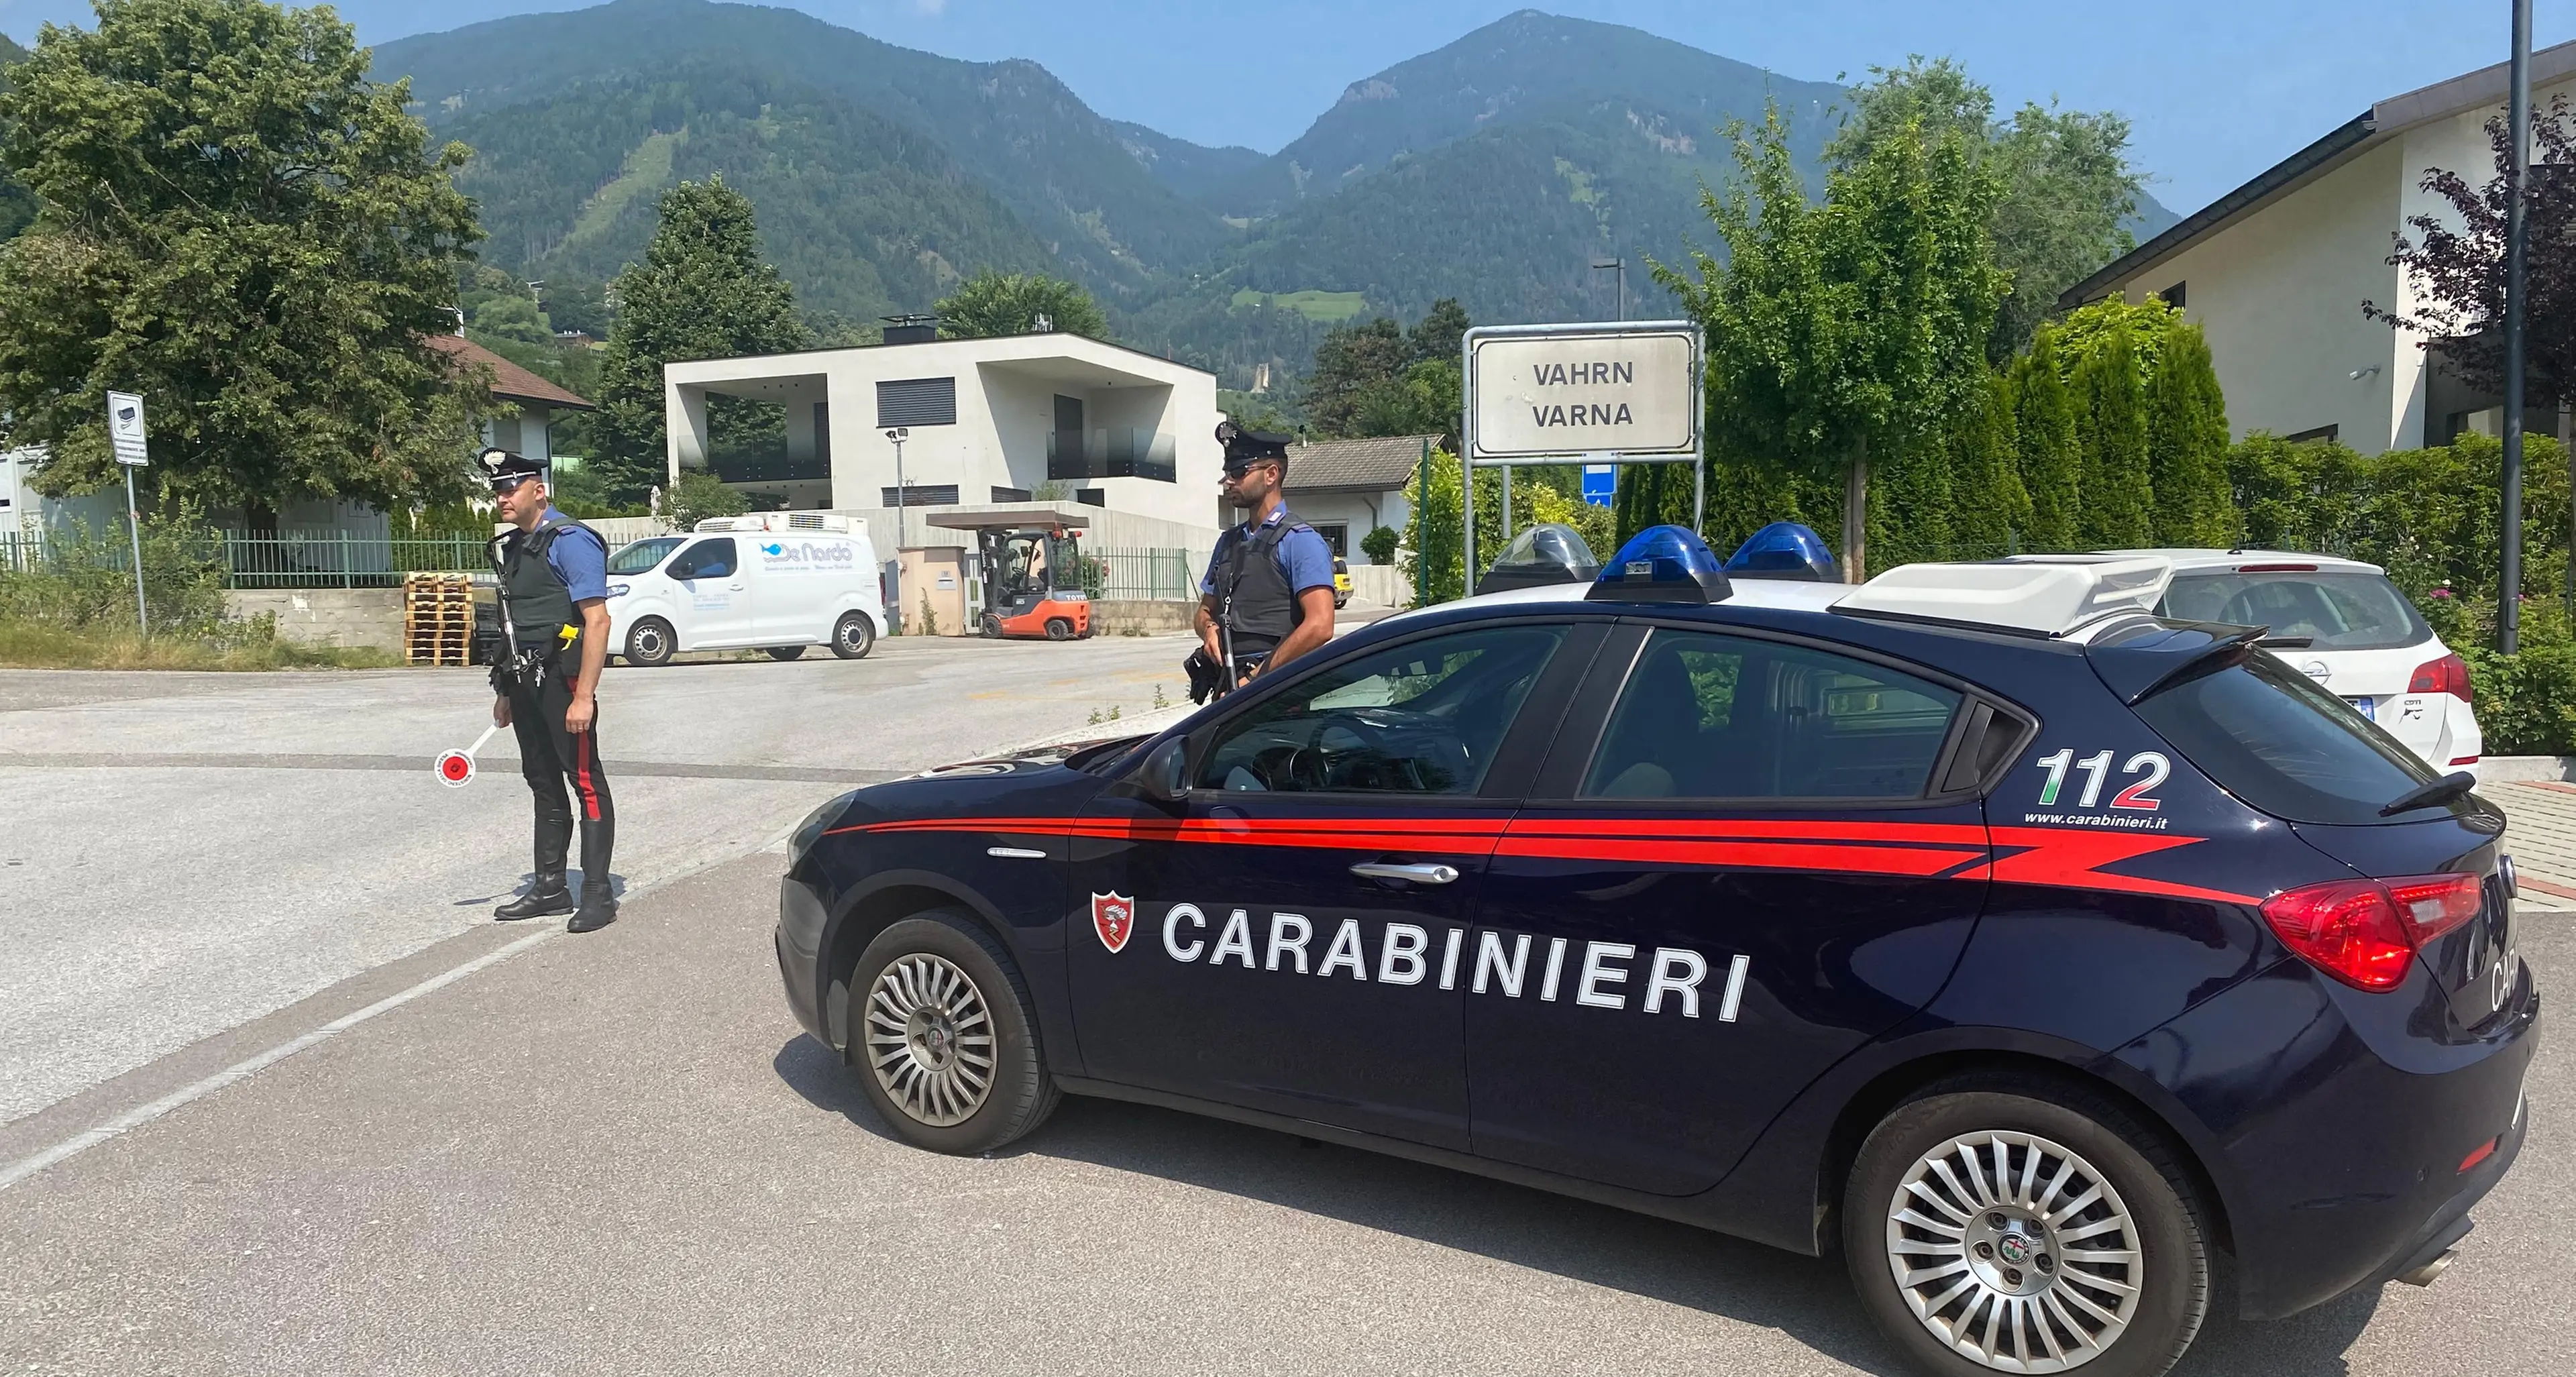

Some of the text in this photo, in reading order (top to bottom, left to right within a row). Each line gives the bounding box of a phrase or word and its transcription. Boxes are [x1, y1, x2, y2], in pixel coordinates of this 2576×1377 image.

[1534, 362, 1633, 386] VAHRN
[1532, 403, 1633, 427] VARNA
[765, 543, 801, 562] De
[2037, 749, 2171, 811] 112
[2025, 812, 2168, 830] www.carabinieri.it
[1163, 903, 1750, 1023] CARABINIERI
